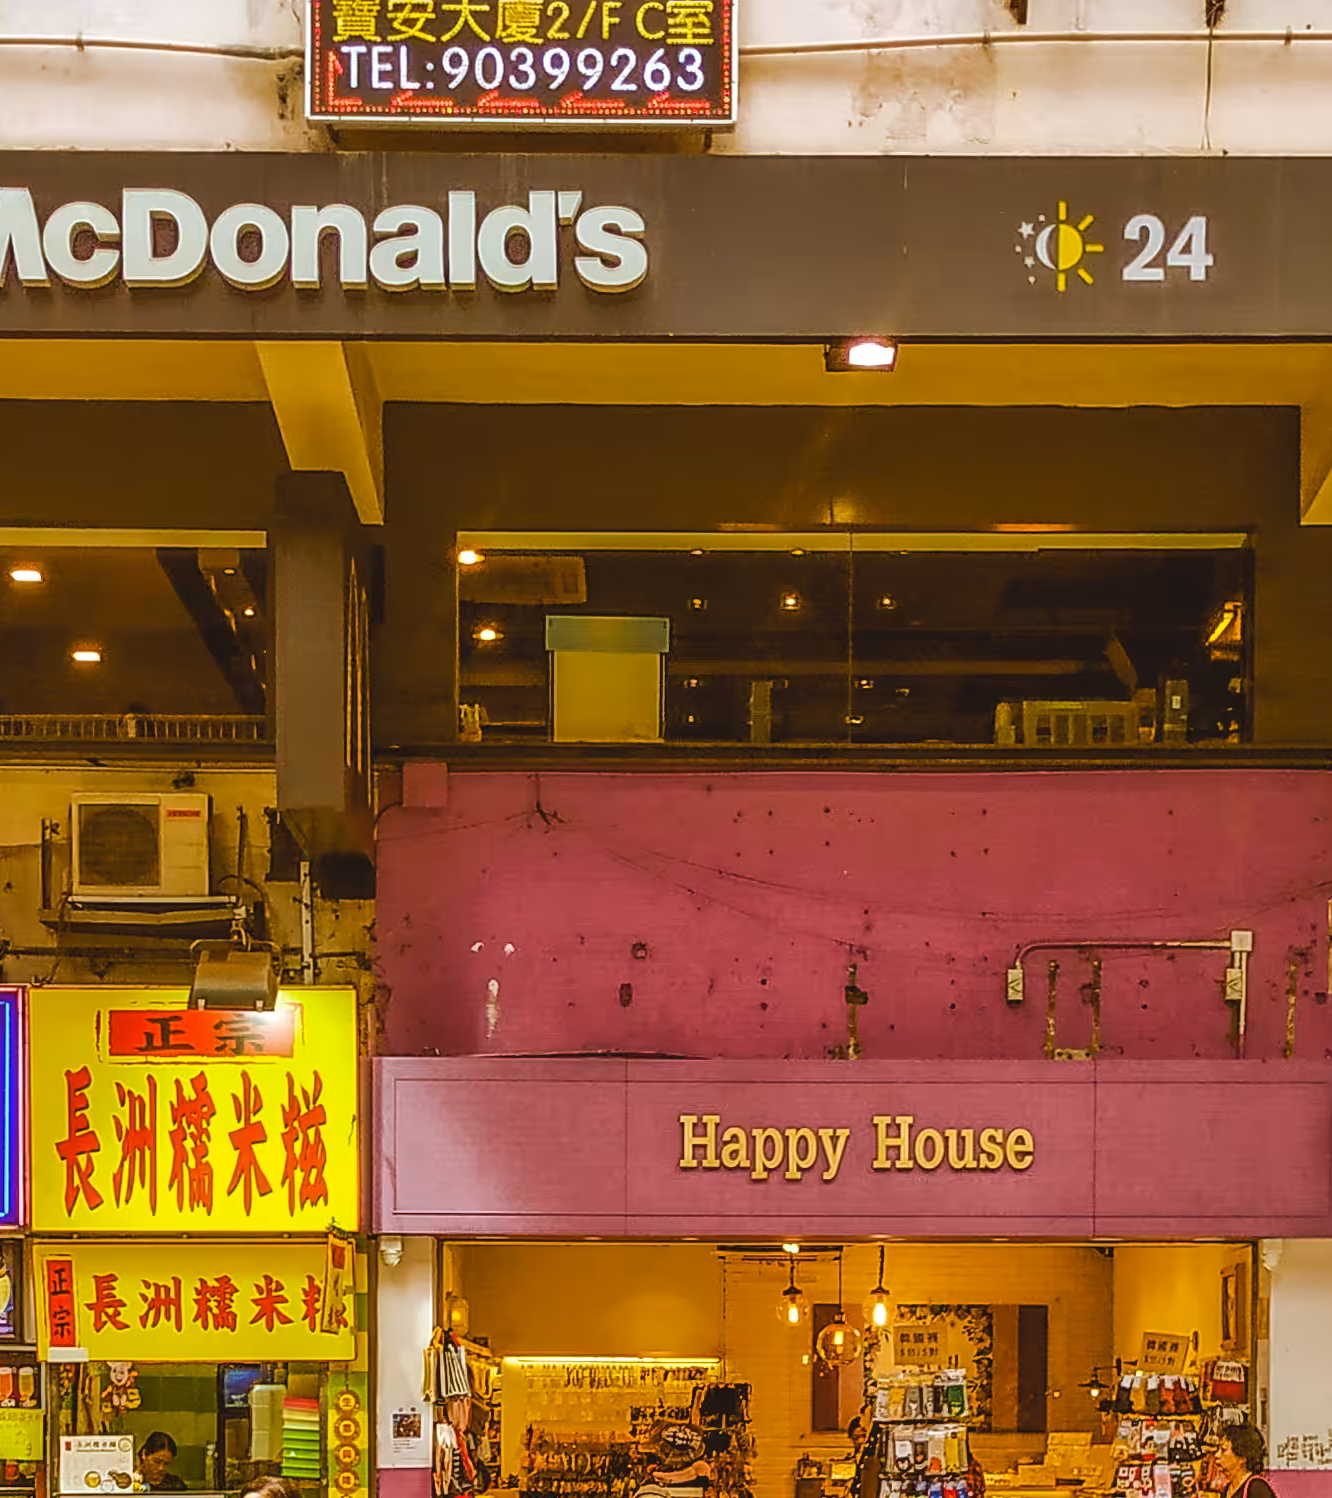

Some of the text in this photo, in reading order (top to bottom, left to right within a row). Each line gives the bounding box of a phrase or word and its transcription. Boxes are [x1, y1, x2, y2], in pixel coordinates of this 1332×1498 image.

[341, 46, 706, 91] TEL:90399263
[1122, 214, 1214, 281] 24
[135, 1015, 266, 1057] 正宗
[55, 1065, 330, 1218] 長洲糯米糍
[678, 1114, 1036, 1181] Happy House
[49, 1266, 74, 1339] 正宗
